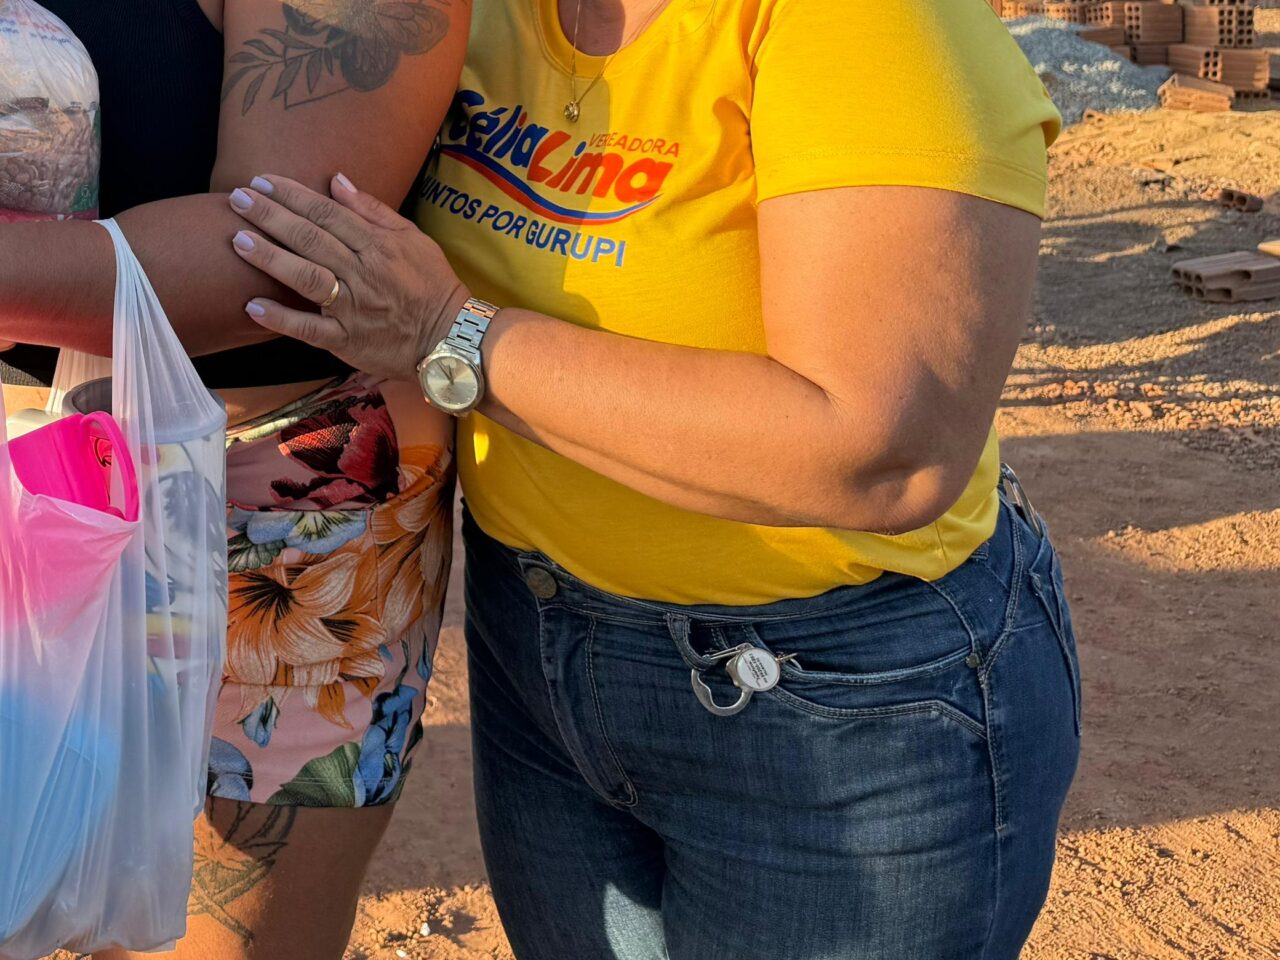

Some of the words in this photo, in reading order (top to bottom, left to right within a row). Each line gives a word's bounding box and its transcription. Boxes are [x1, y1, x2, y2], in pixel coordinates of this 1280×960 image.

[526, 130, 673, 203] Lima
[590, 132, 680, 158] VEREADORA
[419, 176, 480, 220] UNTOS
[477, 204, 527, 239] POR
[526, 220, 627, 268] GURUPI
